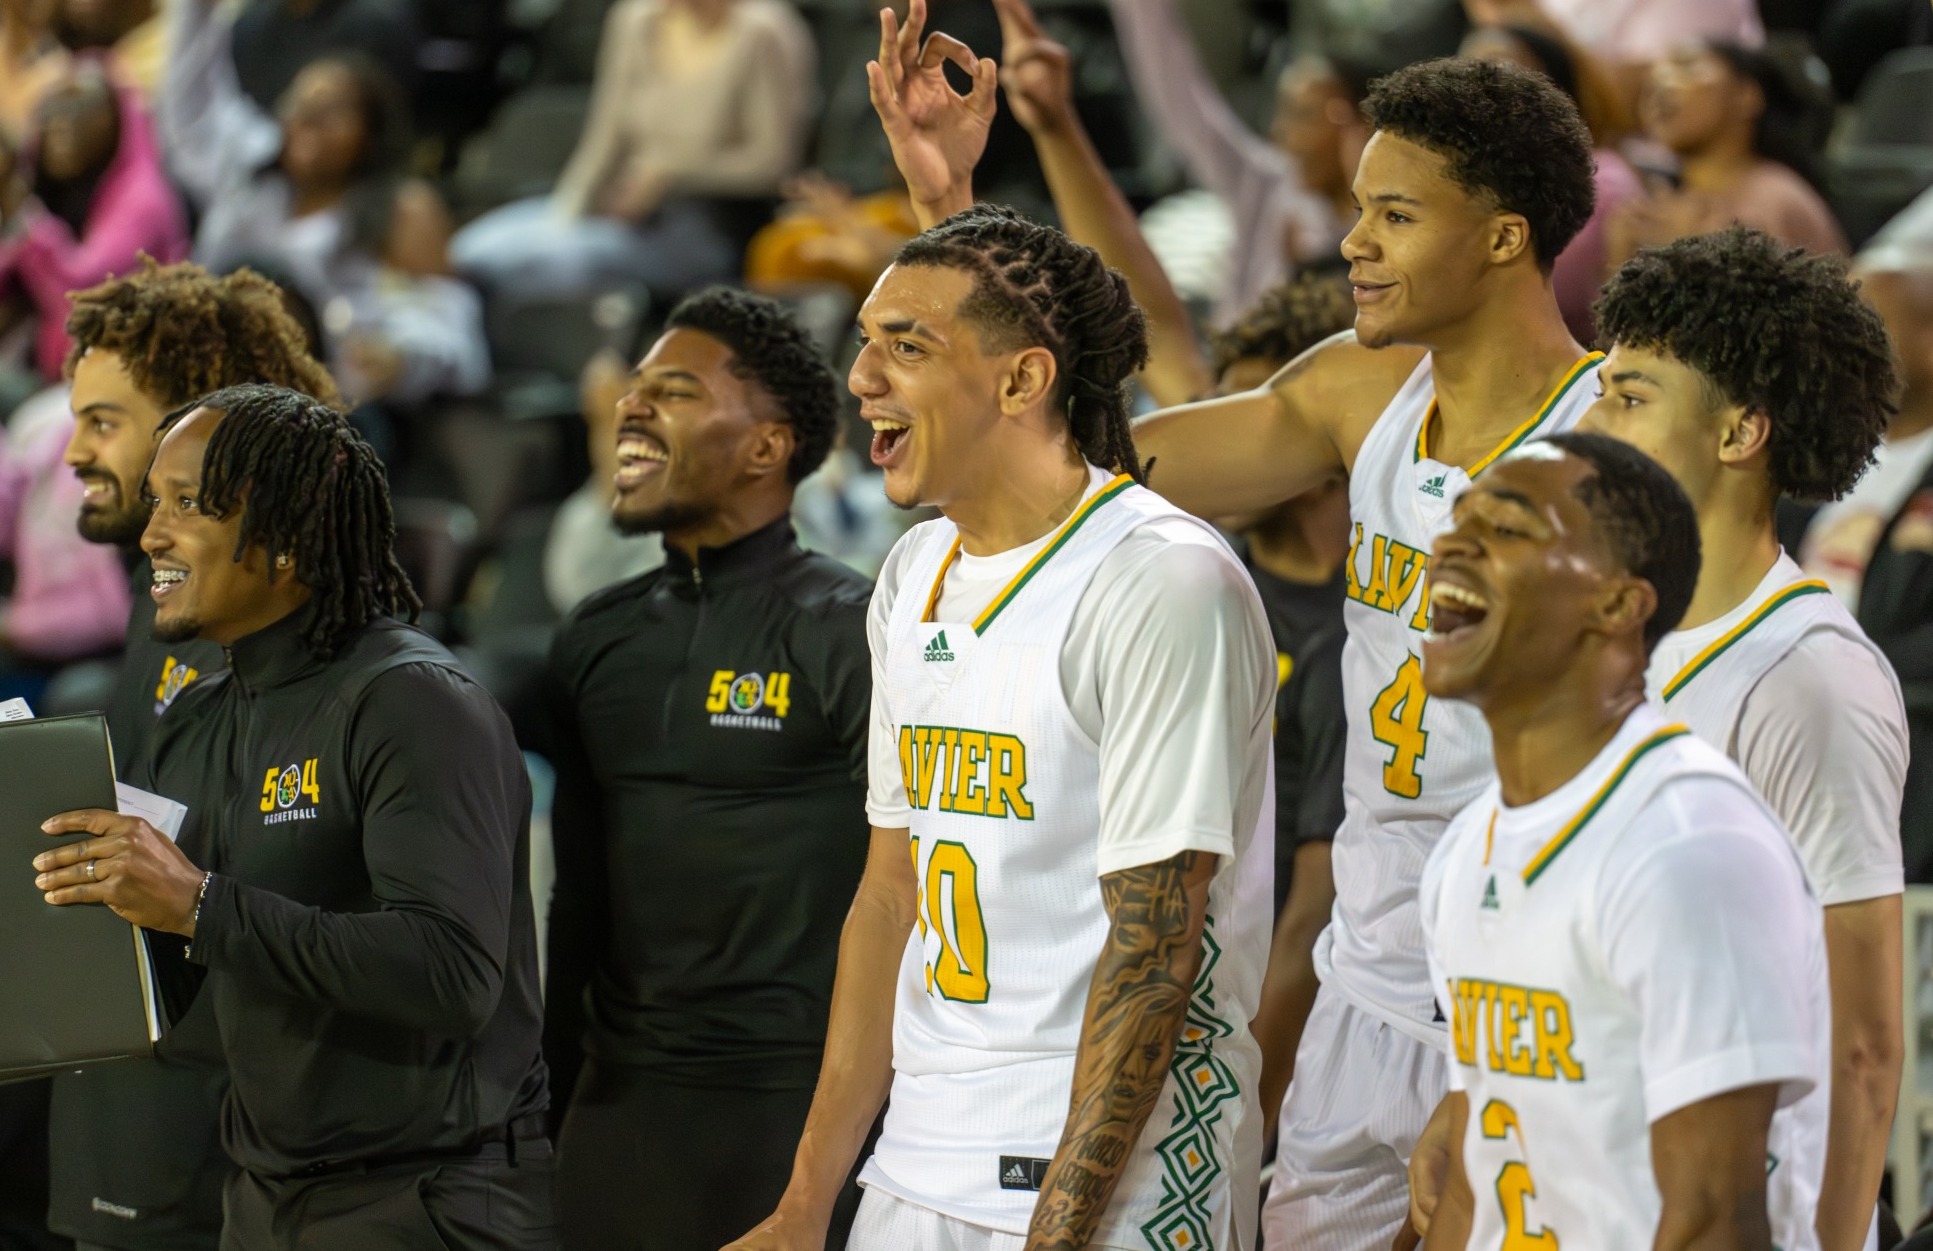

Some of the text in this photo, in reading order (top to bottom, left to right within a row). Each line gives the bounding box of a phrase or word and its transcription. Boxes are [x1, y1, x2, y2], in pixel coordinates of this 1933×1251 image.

[923, 649, 955, 662] adidas
[1370, 648, 1429, 799] 4
[892, 724, 1034, 820] AVIER
[264, 808, 317, 825] BASKETBALL
[1002, 1176, 1029, 1184] adidas
